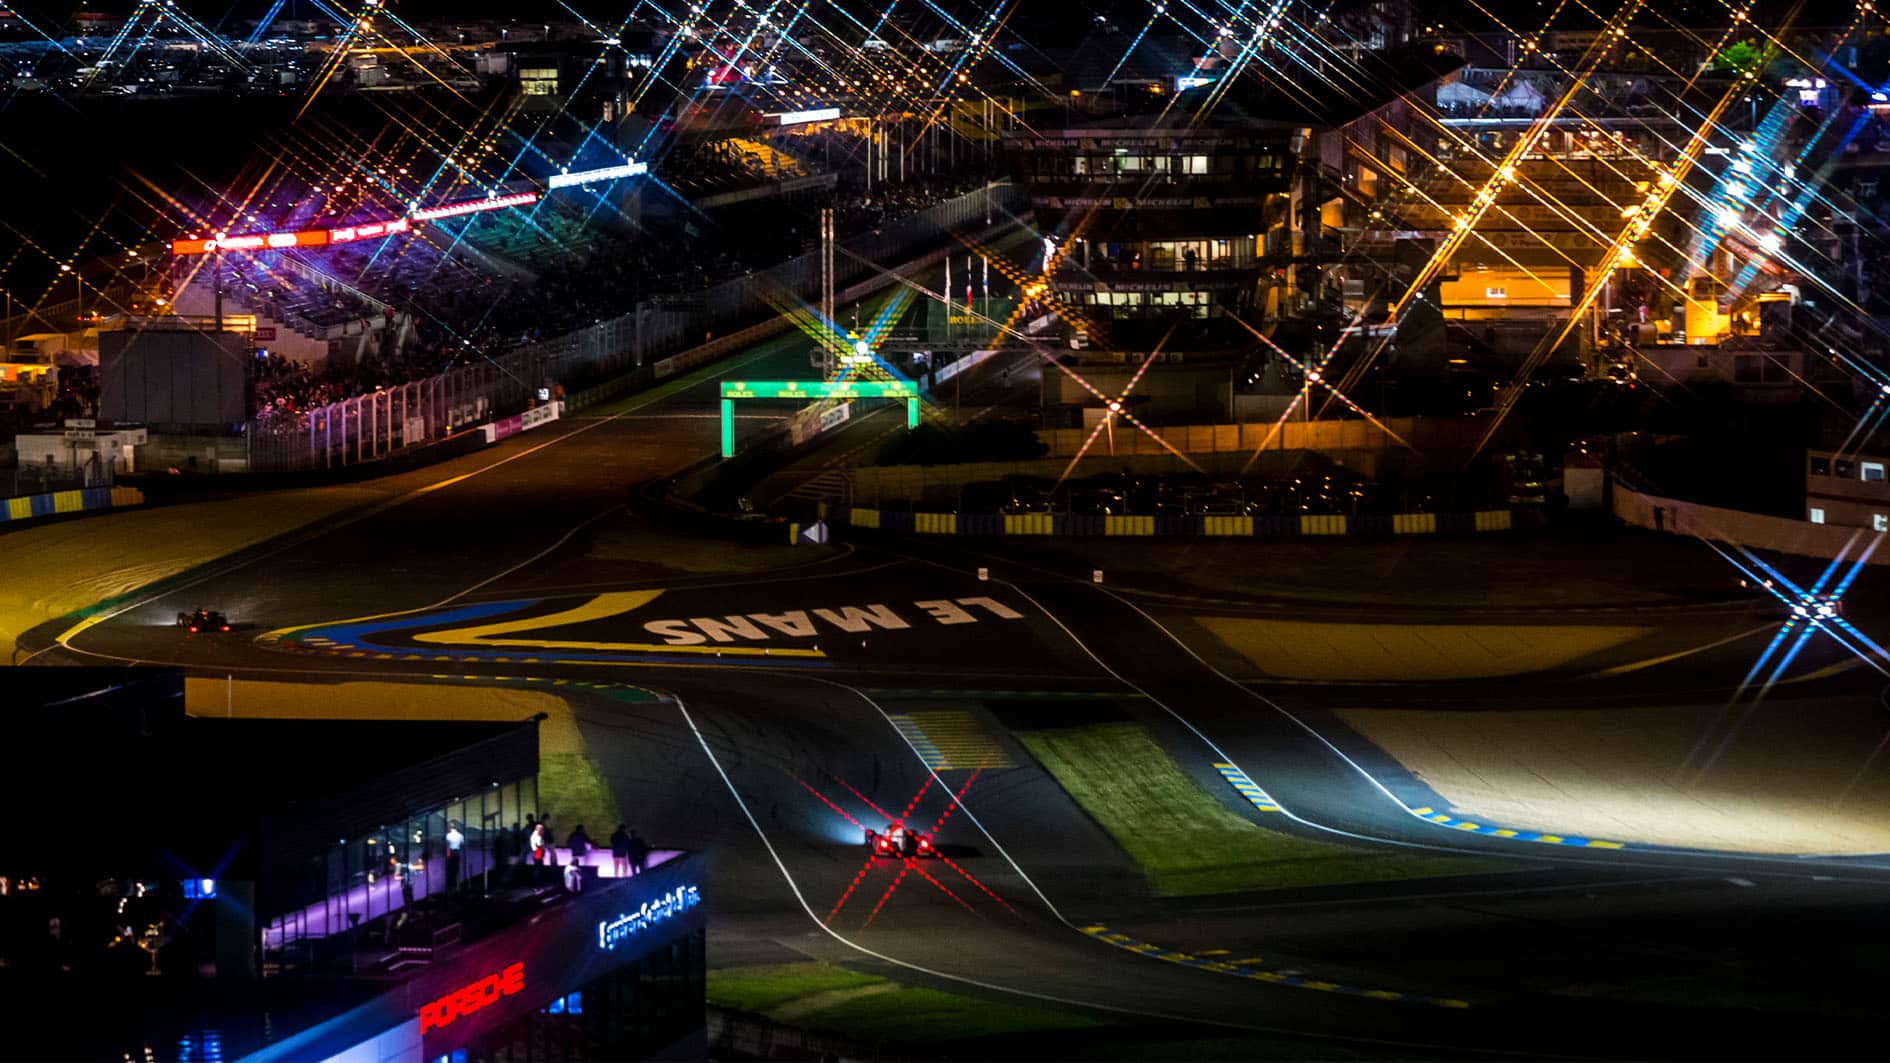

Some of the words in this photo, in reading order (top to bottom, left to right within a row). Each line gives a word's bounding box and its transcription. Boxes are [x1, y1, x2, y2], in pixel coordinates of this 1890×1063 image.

[1064, 198, 1112, 207] MICHELIN
[1136, 198, 1192, 207] MICHELIN
[643, 603, 913, 646] MANS
[913, 596, 1025, 626] LE
[419, 960, 526, 1036] PORSCHE
